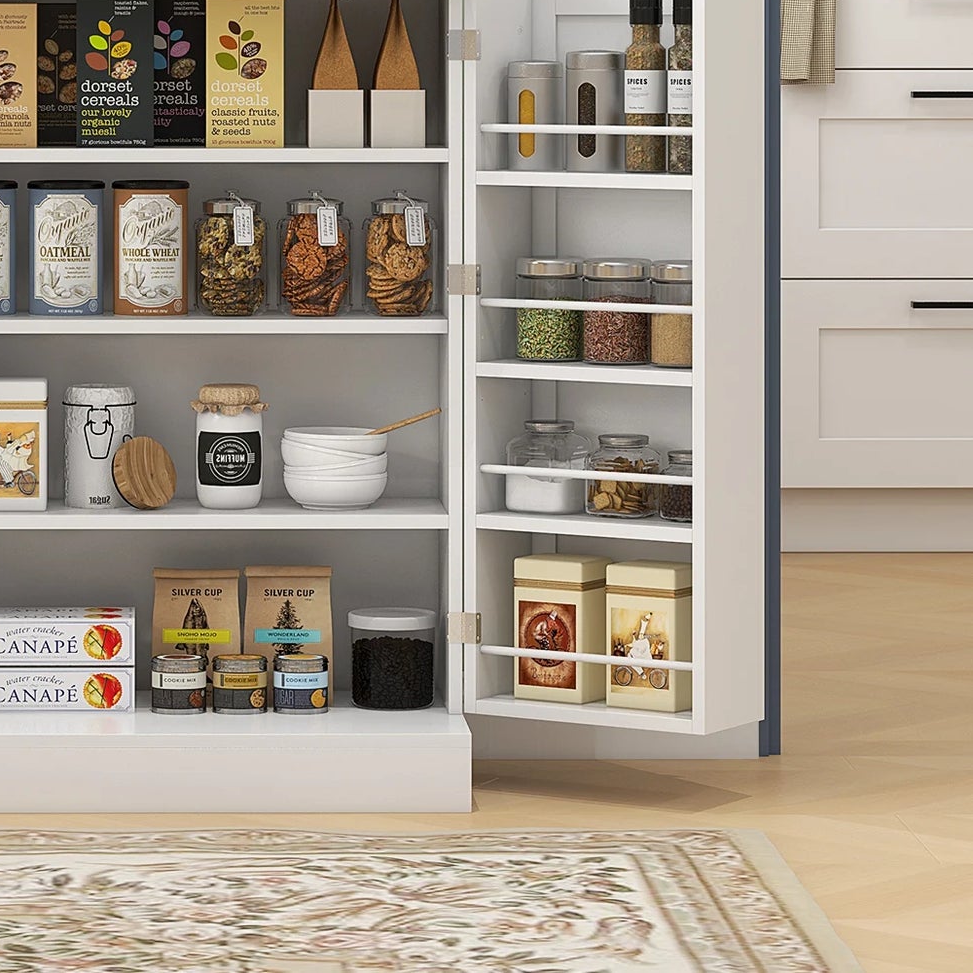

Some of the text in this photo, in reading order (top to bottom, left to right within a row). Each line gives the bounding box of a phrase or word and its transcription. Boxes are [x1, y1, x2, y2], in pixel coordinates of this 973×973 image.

[81, 80, 133, 93] dorset
[211, 80, 263, 92] dorset
[81, 94, 139, 106] cereals
[211, 94, 269, 106] cereals
[81, 108, 132, 118] our lovely
[211, 108, 280, 117] classic fruits,
[81, 118, 120, 127] organic
[211, 118, 249, 126] roasted
[81, 128, 116, 136] muesli
[211, 127, 251, 135] & seeds
[38, 207, 89, 245] Organic
[122, 207, 175, 245] Organic
[40, 246, 91, 257] OATMEAL
[122, 248, 180, 257] WHOLE WHEAT
[171, 588, 223, 596] SILVER CUP
[264, 589, 315, 597] SILVER CUP
[6, 626, 65, 637] water cracker
[6, 675, 65, 686] water cracker
